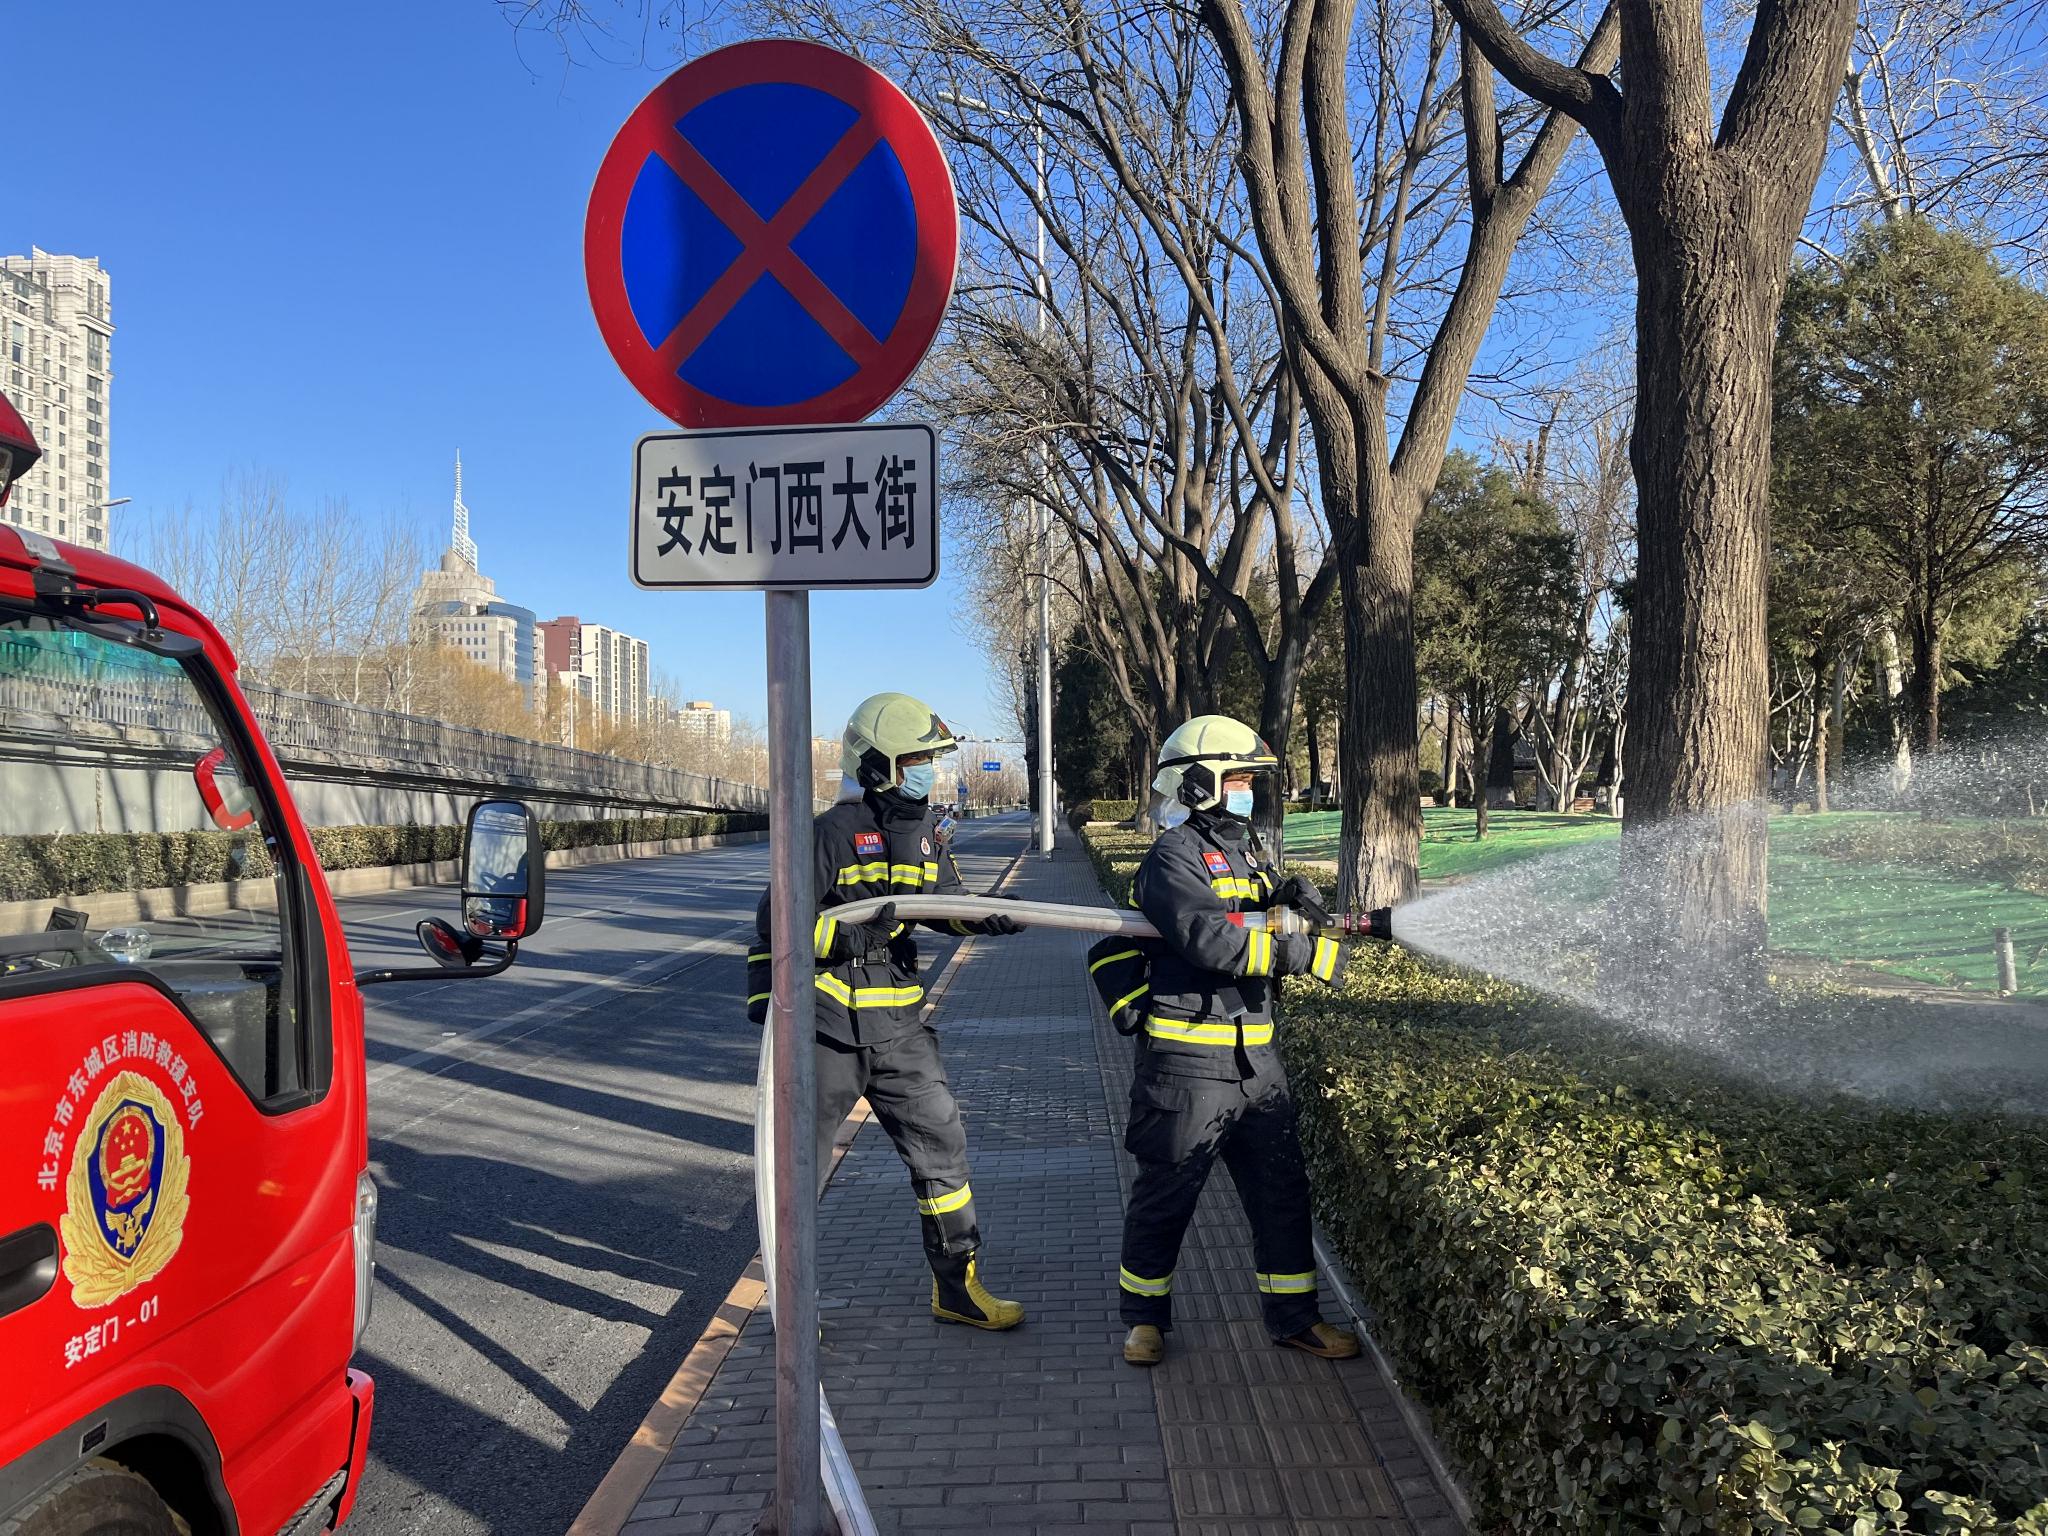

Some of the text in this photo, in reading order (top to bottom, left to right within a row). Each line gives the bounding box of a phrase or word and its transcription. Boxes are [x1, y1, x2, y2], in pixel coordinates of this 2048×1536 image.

[656, 454, 917, 557] 安定门西大街
[863, 834, 879, 845] 119
[37, 1029, 204, 1192] 北京市东城区消防救援支队
